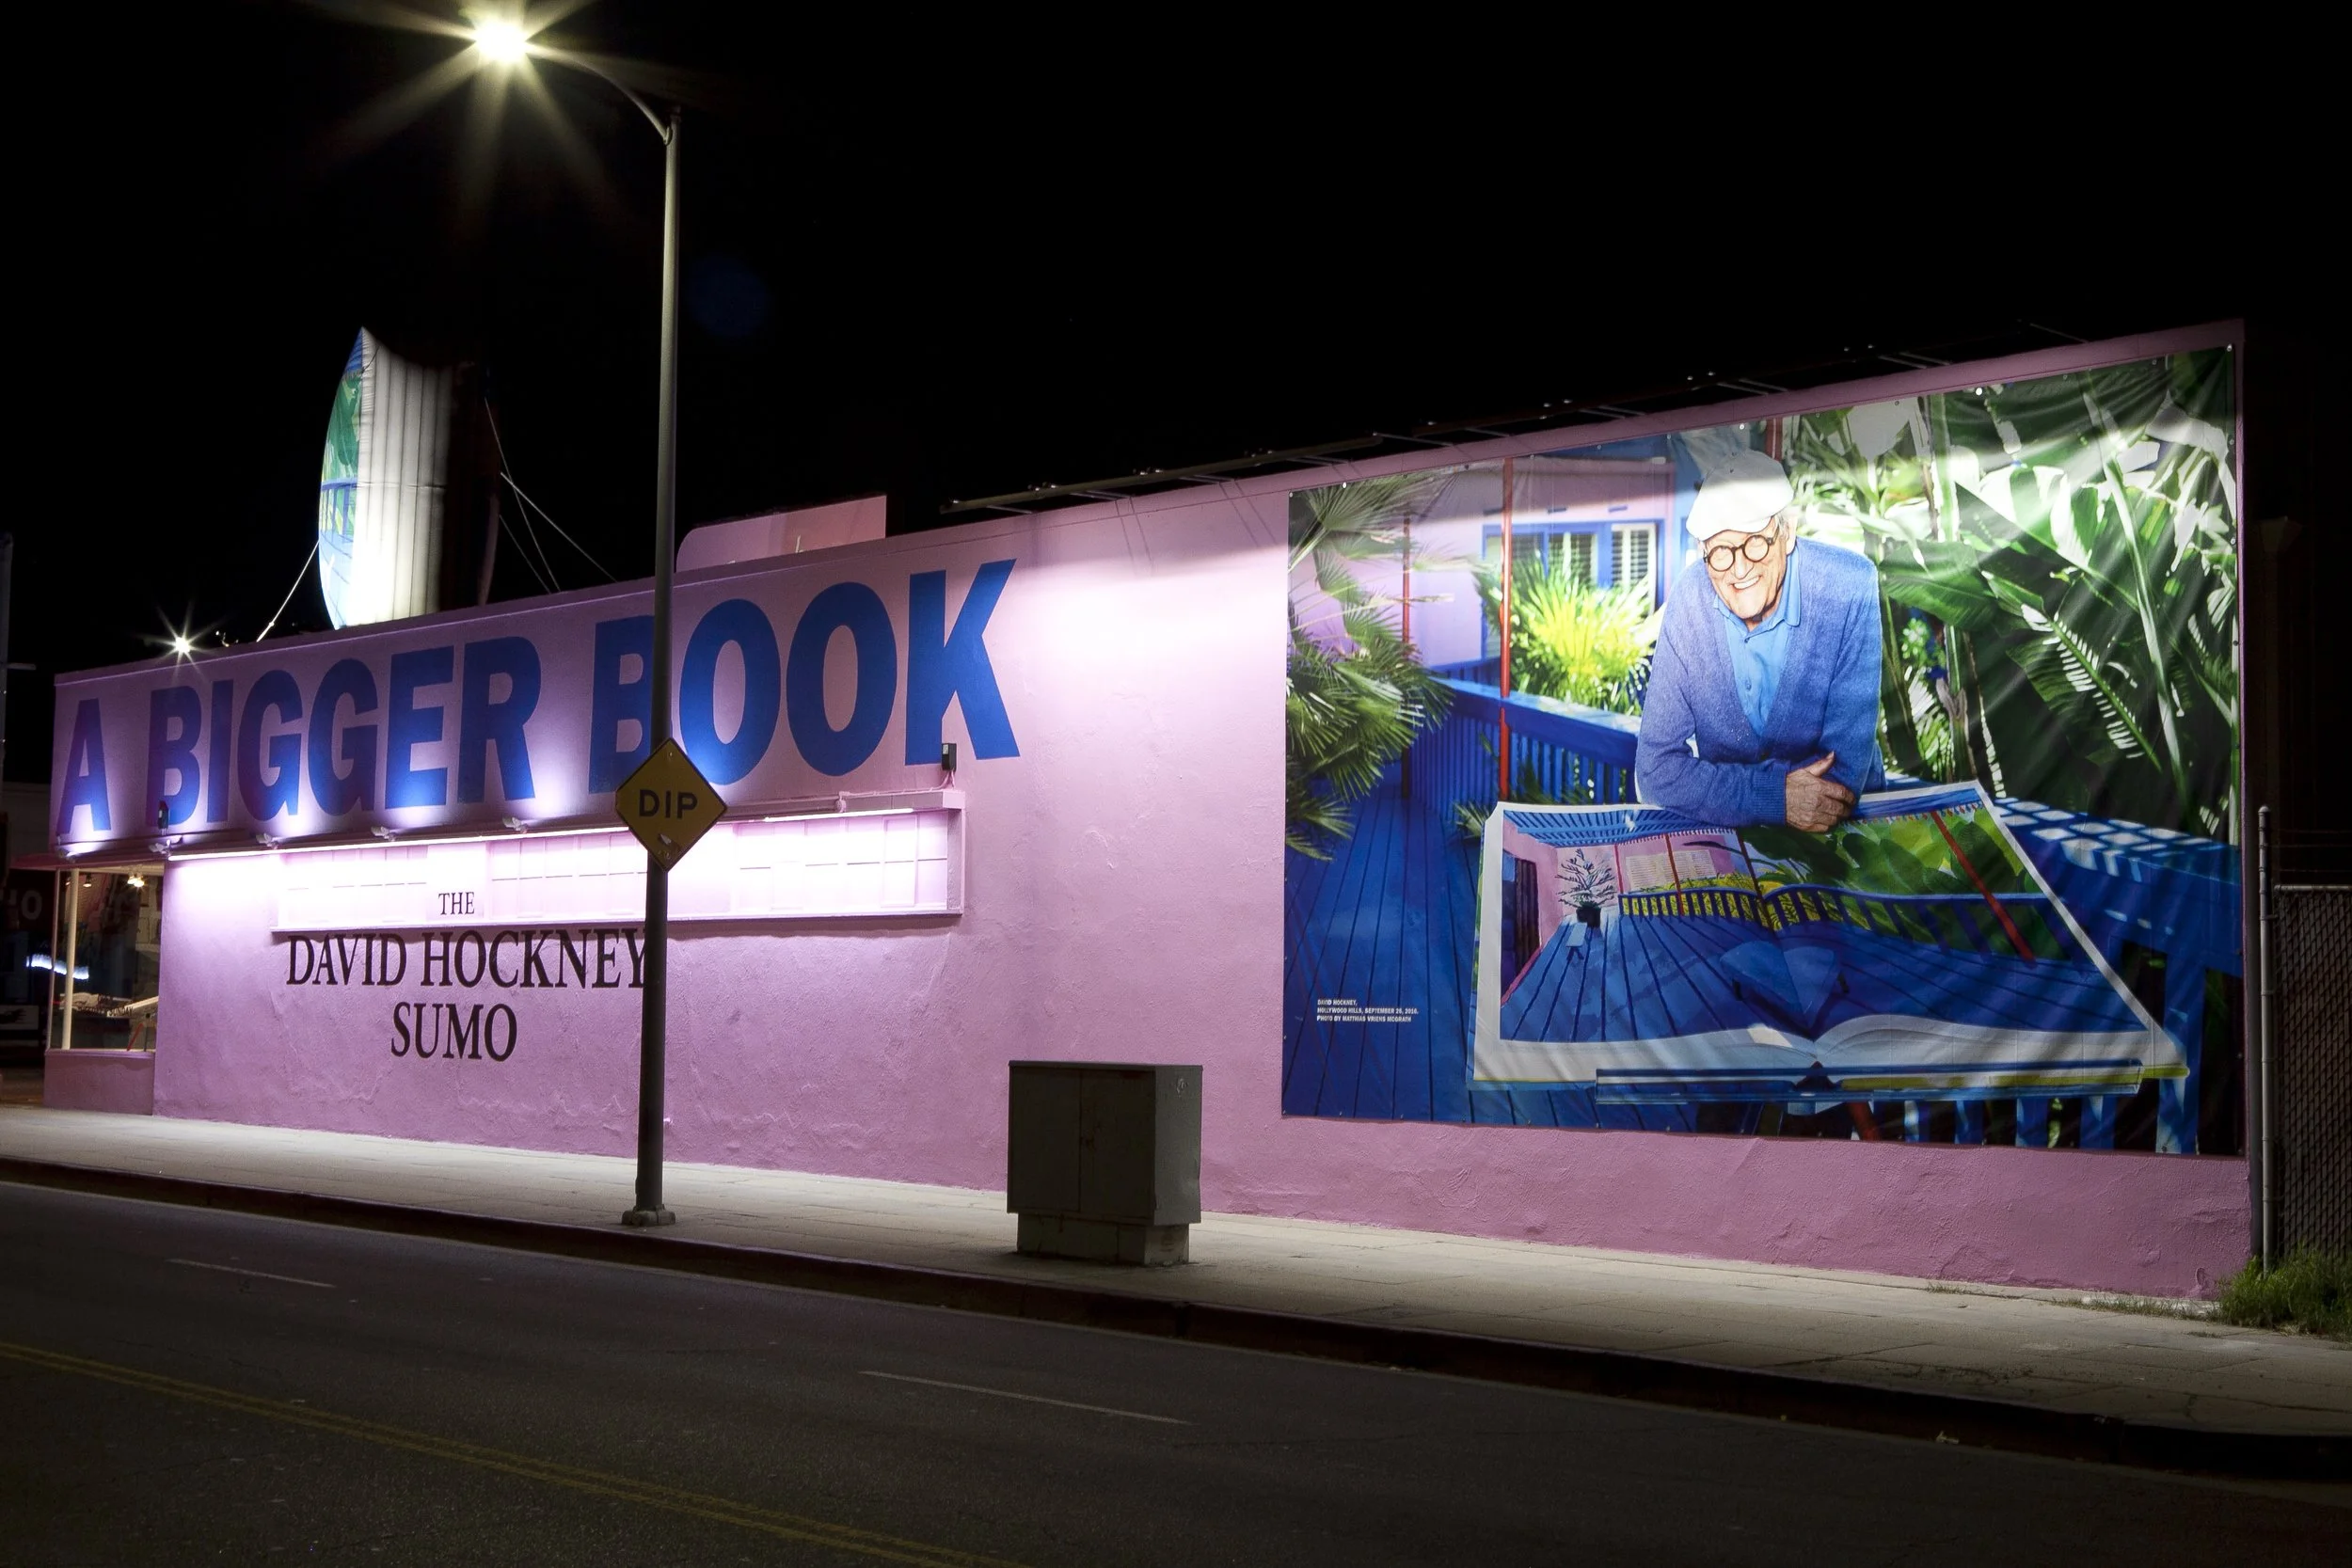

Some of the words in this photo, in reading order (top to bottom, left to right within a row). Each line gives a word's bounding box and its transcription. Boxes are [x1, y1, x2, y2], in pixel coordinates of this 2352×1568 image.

[56, 697, 112, 835] A
[145, 635, 543, 828] BIGGER
[588, 558, 1021, 796] BOOK
[638, 788, 698, 819] DIP
[437, 891, 475, 915] THE
[286, 933, 407, 987] DAVID
[420, 928, 645, 989] HOCKNEY
[390, 1002, 517, 1061] SUMO
